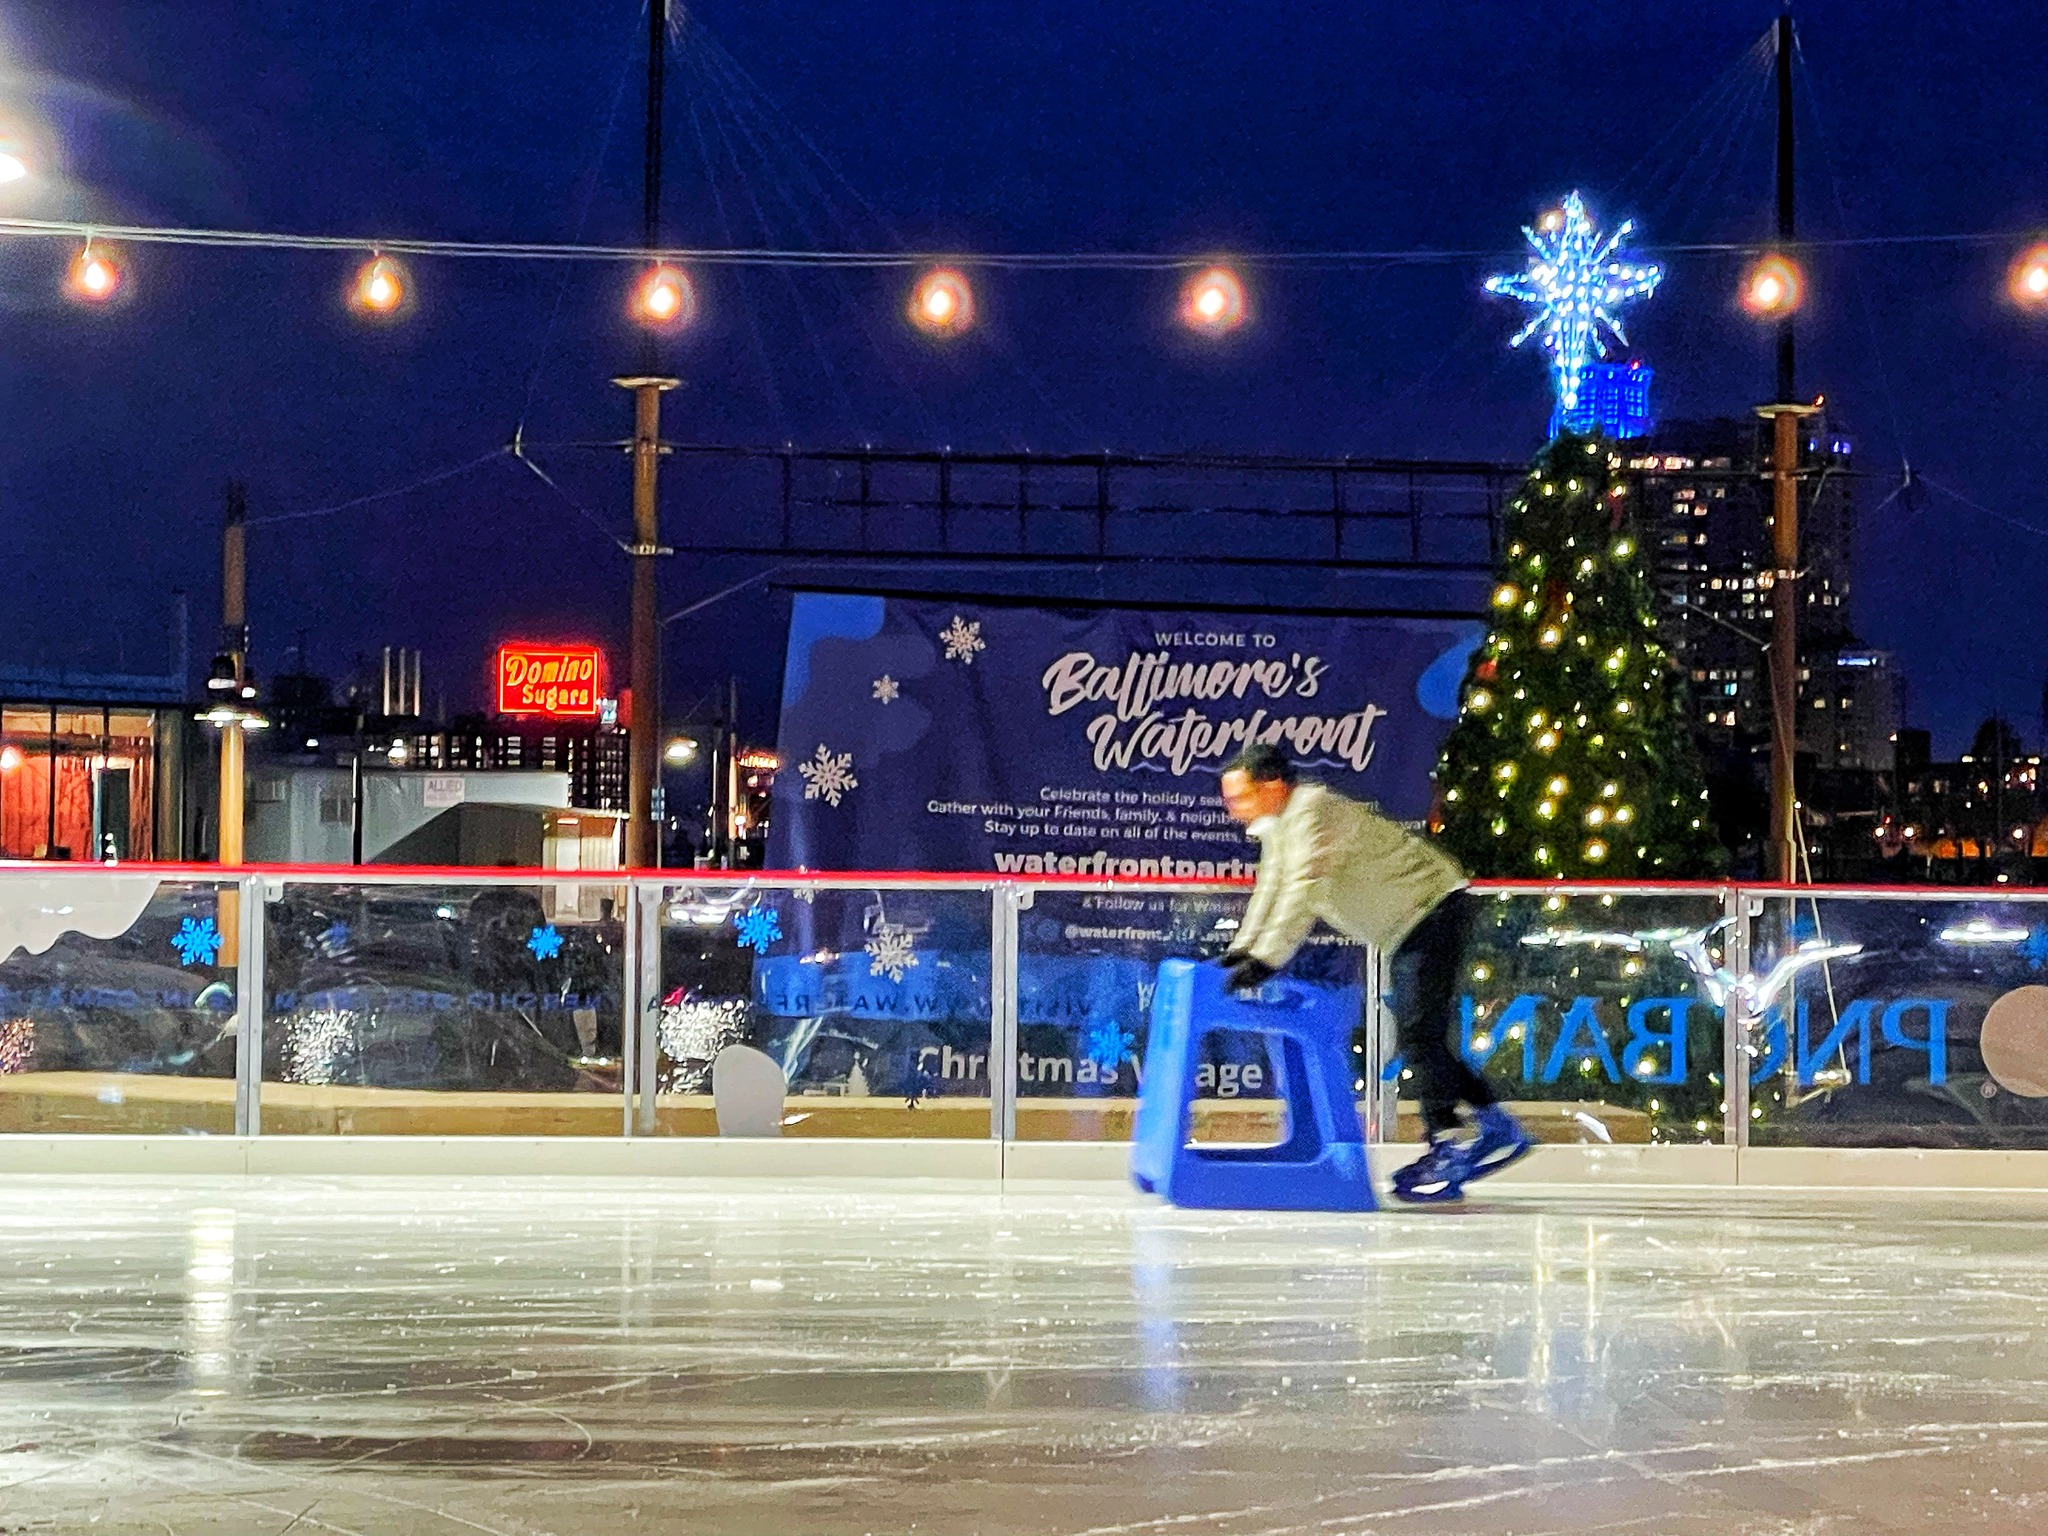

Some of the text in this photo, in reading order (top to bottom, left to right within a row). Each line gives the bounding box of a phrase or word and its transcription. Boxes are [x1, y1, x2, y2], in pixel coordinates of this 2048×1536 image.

[1155, 632, 1277, 649] WELCOME TO
[505, 654, 593, 686] Domino
[522, 684, 589, 711] Sugars
[1042, 651, 1330, 722] Baltimore's
[1086, 703, 1388, 776] Waterfront
[1040, 786, 1223, 808] Celebrate the holiday sea
[927, 799, 978, 815] Gather
[981, 803, 1014, 816] with
[1017, 806, 1051, 820] your
[1166, 811, 1176, 823] &
[984, 820, 1017, 836] Stay
[1020, 824, 1040, 838] up
[1043, 823, 1060, 836] to
[1063, 823, 1097, 837] date
[1100, 827, 1120, 838] on
[1123, 826, 1141, 839] all
[1144, 826, 1158, 839] of
[1164, 827, 1188, 840] the
